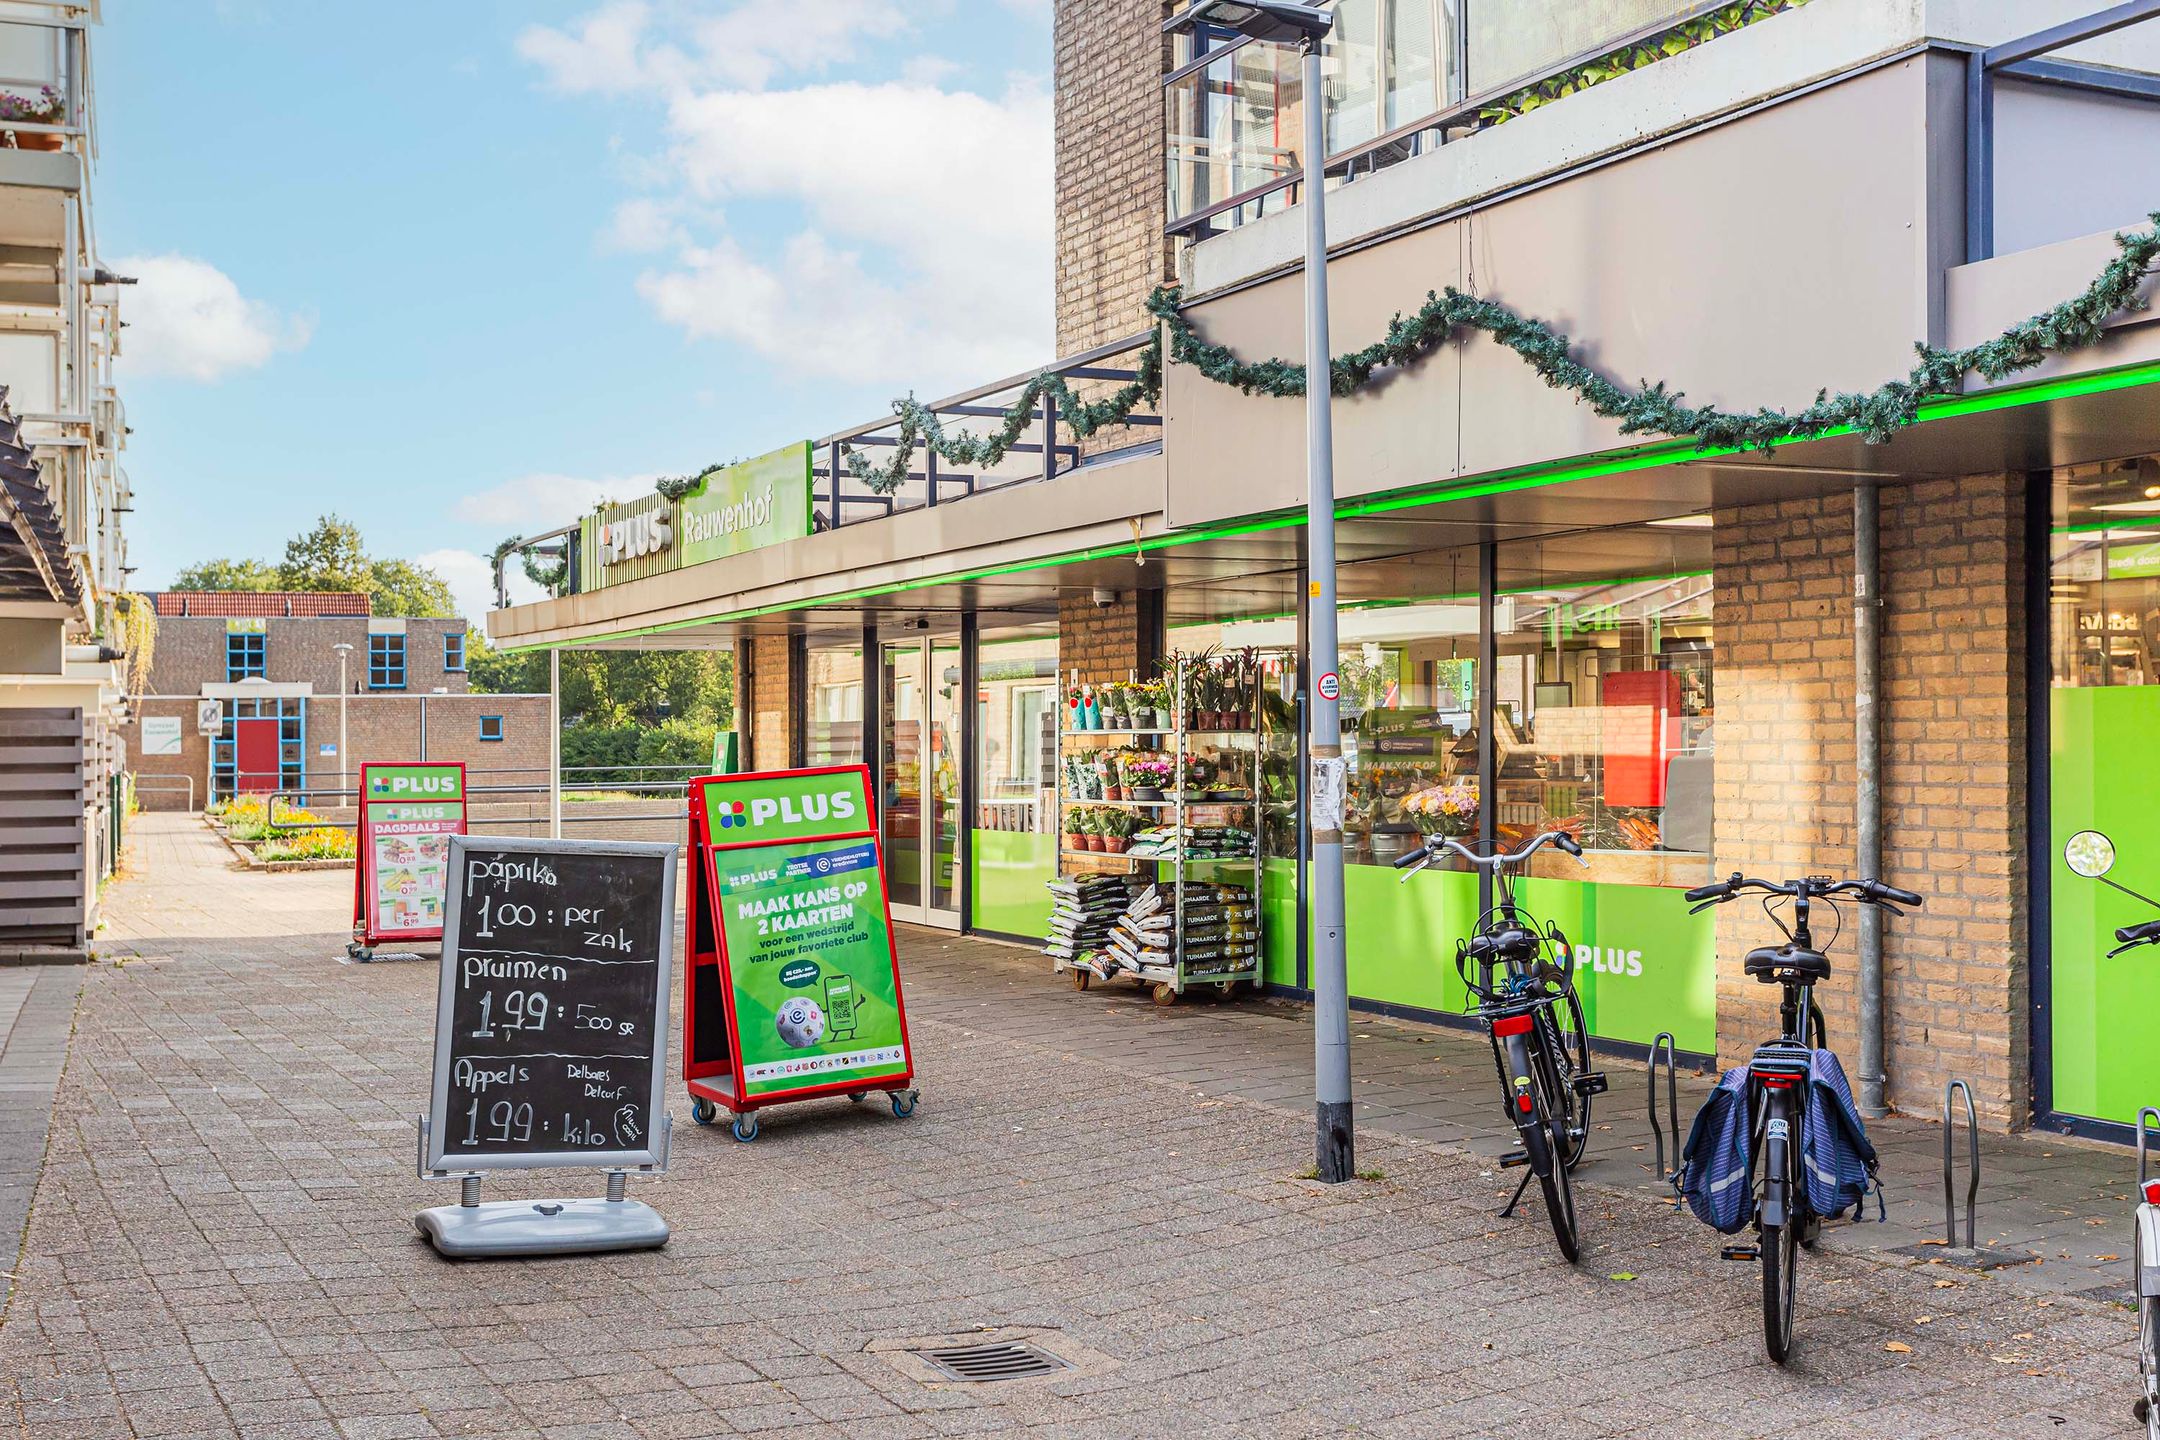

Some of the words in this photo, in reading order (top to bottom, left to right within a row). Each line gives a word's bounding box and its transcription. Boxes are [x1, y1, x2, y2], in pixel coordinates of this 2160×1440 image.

[612, 507, 669, 563] PLUS
[684, 484, 773, 545] Rauwenhof
[1464, 681, 1470, 691] 5
[393, 777, 455, 793] PLUS
[400, 806, 445, 819] PLUS
[751, 791, 855, 827] PLUS
[375, 822, 441, 834] DAGDEALS
[740, 869, 778, 886] PLUS
[738, 896, 792, 920] MAAK
[793, 886, 841, 911] KANS
[844, 881, 868, 900] OP
[564, 907, 605, 927] per
[758, 919, 769, 936] 2
[772, 903, 854, 933] KAARTEN
[1187, 915, 1218, 924] TUINAARDE
[749, 953, 769, 964] van
[770, 949, 796, 962] jouw
[797, 938, 845, 954] favoriete
[846, 931, 869, 945] club
[759, 937, 783, 949] voor
[785, 933, 804, 944] een
[806, 921, 855, 939] wedstrijd
[464, 955, 567, 989] pruimen
[1575, 944, 1643, 977] PLUS
[574, 1003, 613, 1031] 500
[454, 1058, 530, 1093] Appels
[562, 1112, 606, 1146] kilo
